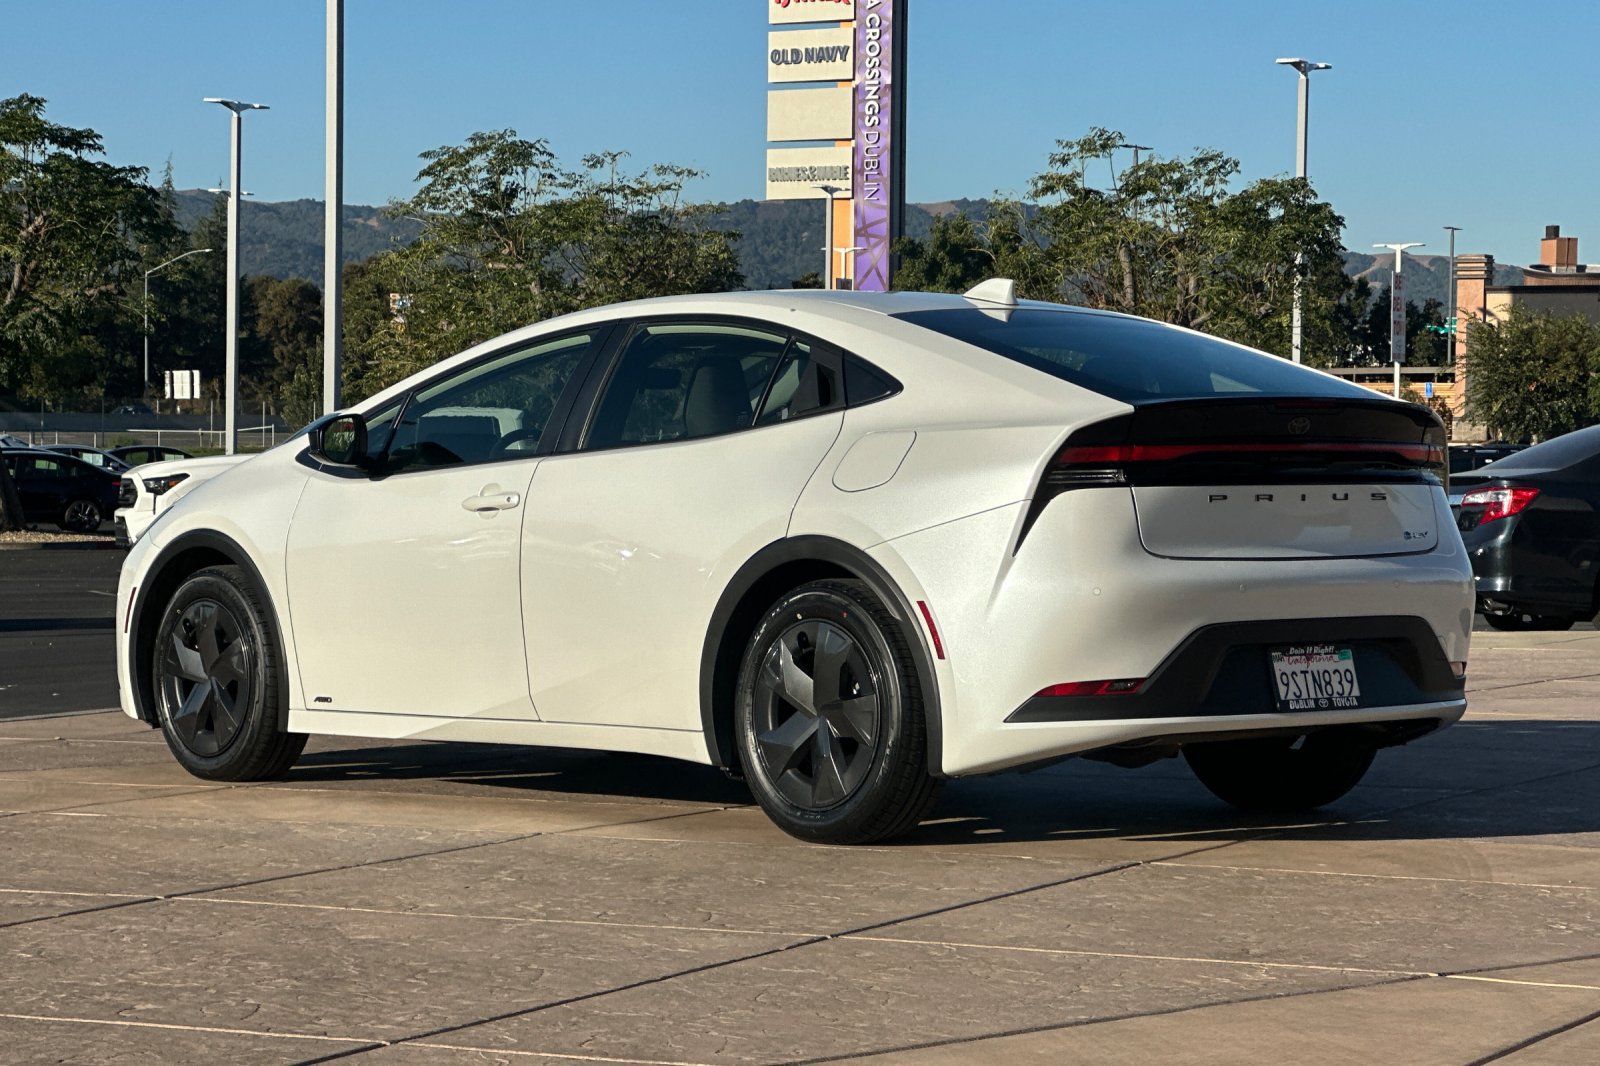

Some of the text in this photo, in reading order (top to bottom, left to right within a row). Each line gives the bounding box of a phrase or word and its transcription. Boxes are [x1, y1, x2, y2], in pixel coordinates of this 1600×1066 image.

[770, 45, 850, 65] OLD NAVY
[864, 13, 882, 127] CROSSINGS
[863, 131, 880, 201] DUBLIN
[1207, 493, 1387, 502] PRIUS
[1280, 668, 1354, 700] 9STN839
[1289, 697, 1358, 710] DUBLIN TOYOTA
